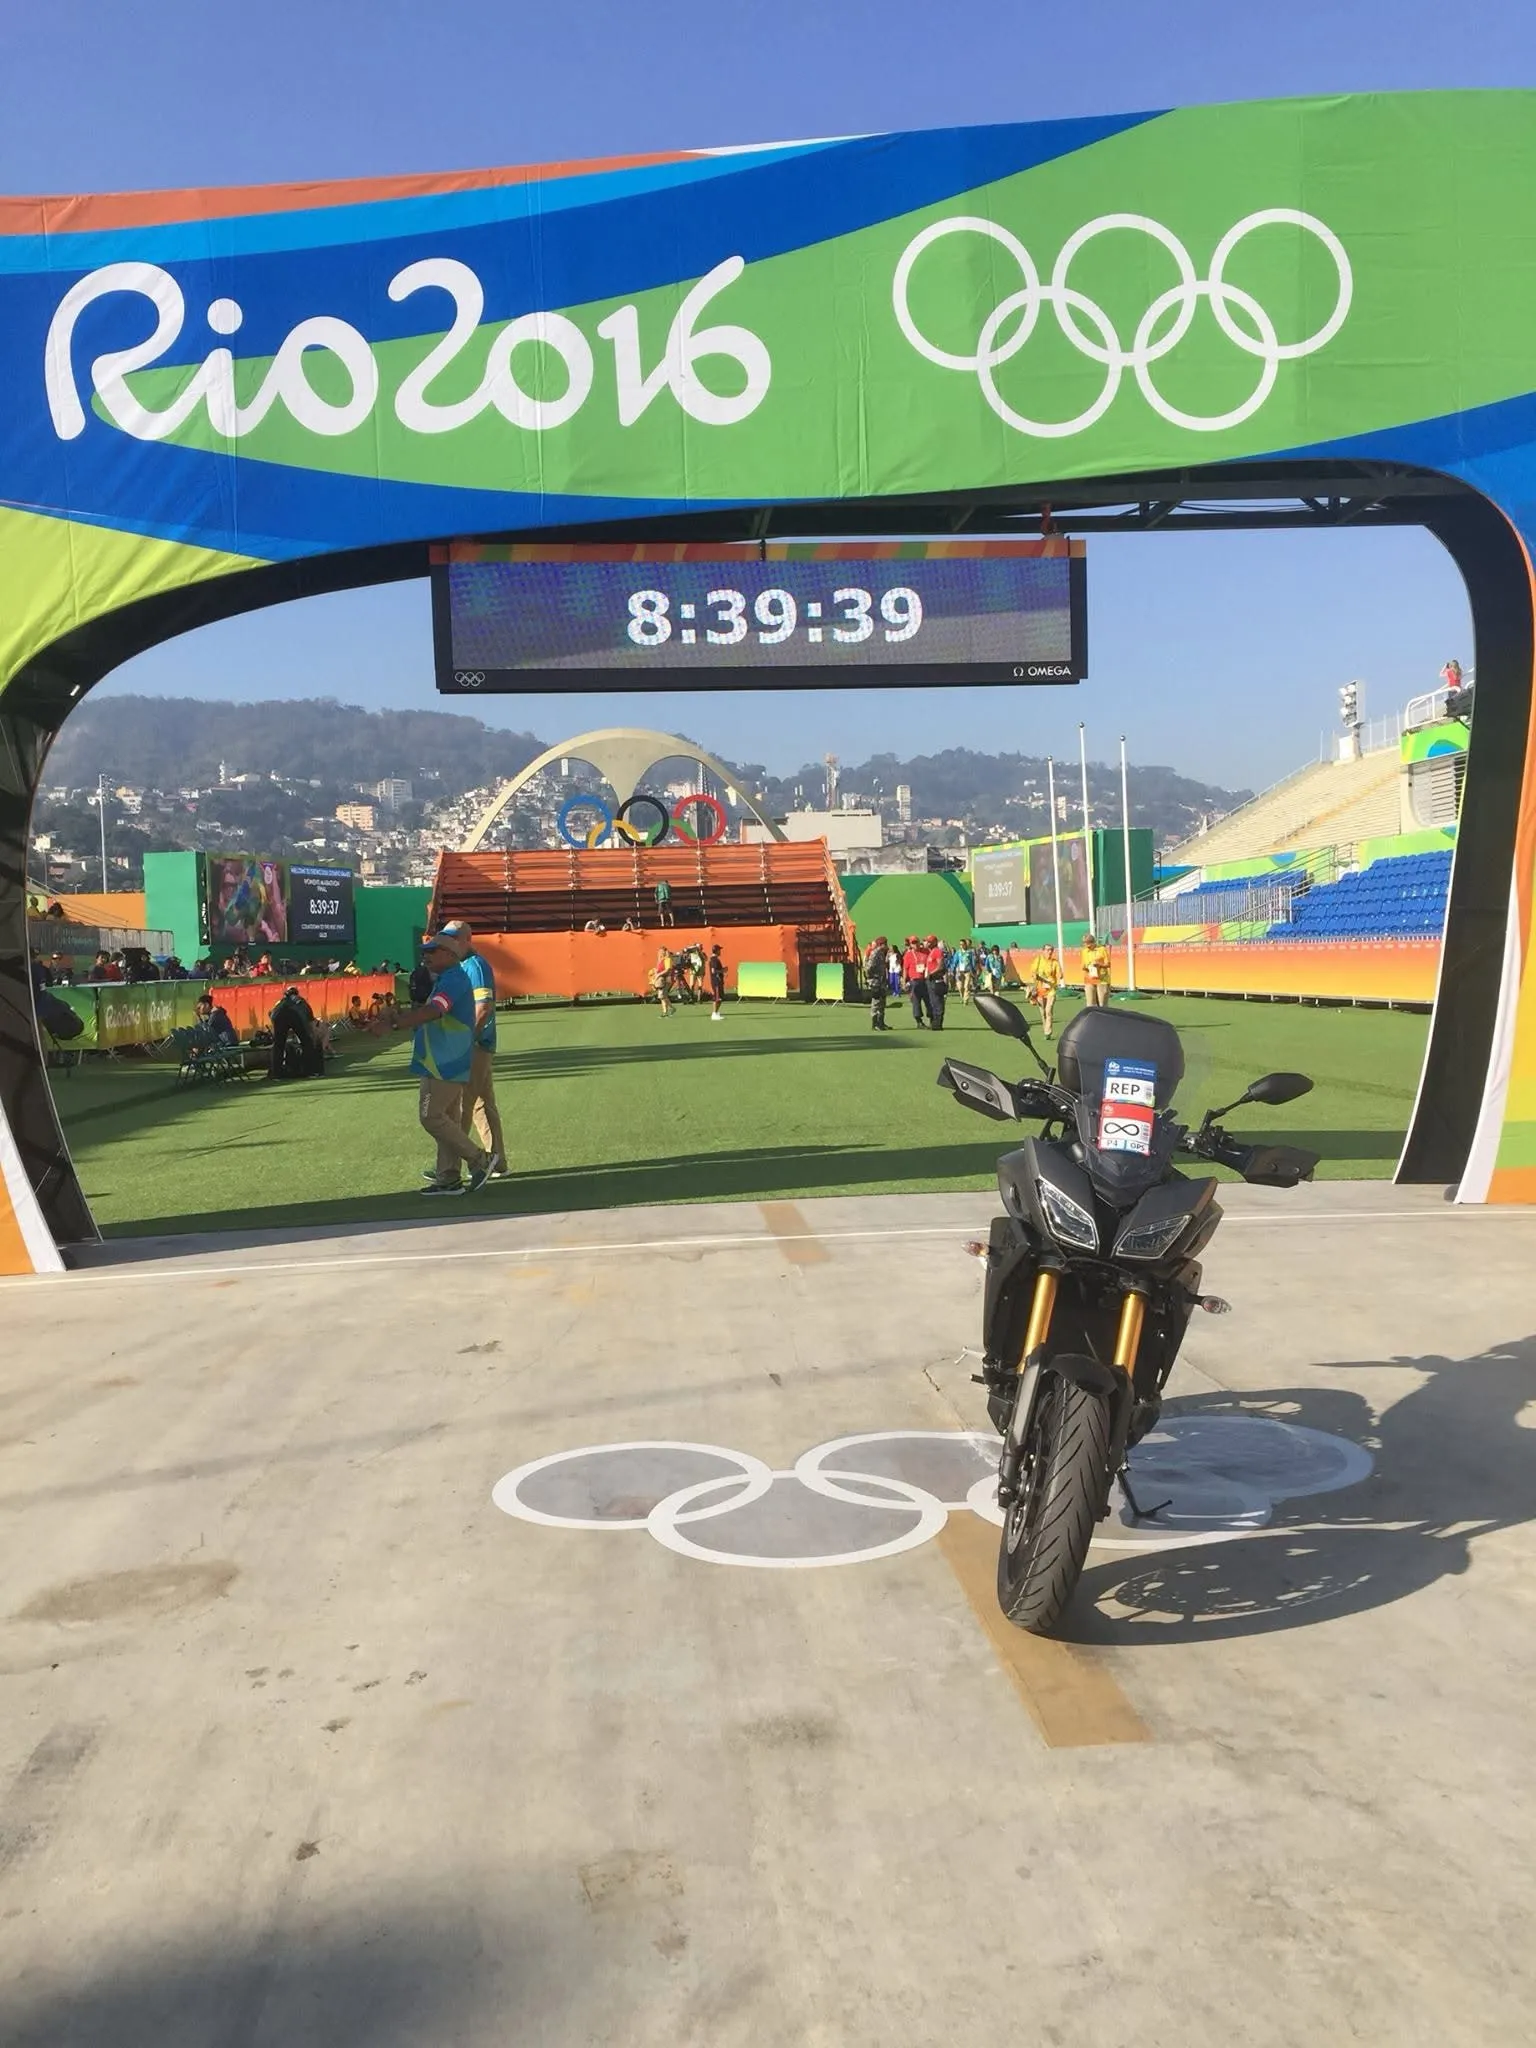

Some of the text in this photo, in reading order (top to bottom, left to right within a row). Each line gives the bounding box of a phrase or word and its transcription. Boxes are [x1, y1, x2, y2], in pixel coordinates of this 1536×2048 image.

[626, 587, 923, 646] 8:39:39
[1027, 665, 1072, 677] OMEGA
[309, 899, 339, 915] 8:39:37
[1110, 1082, 1140, 1095] REP
